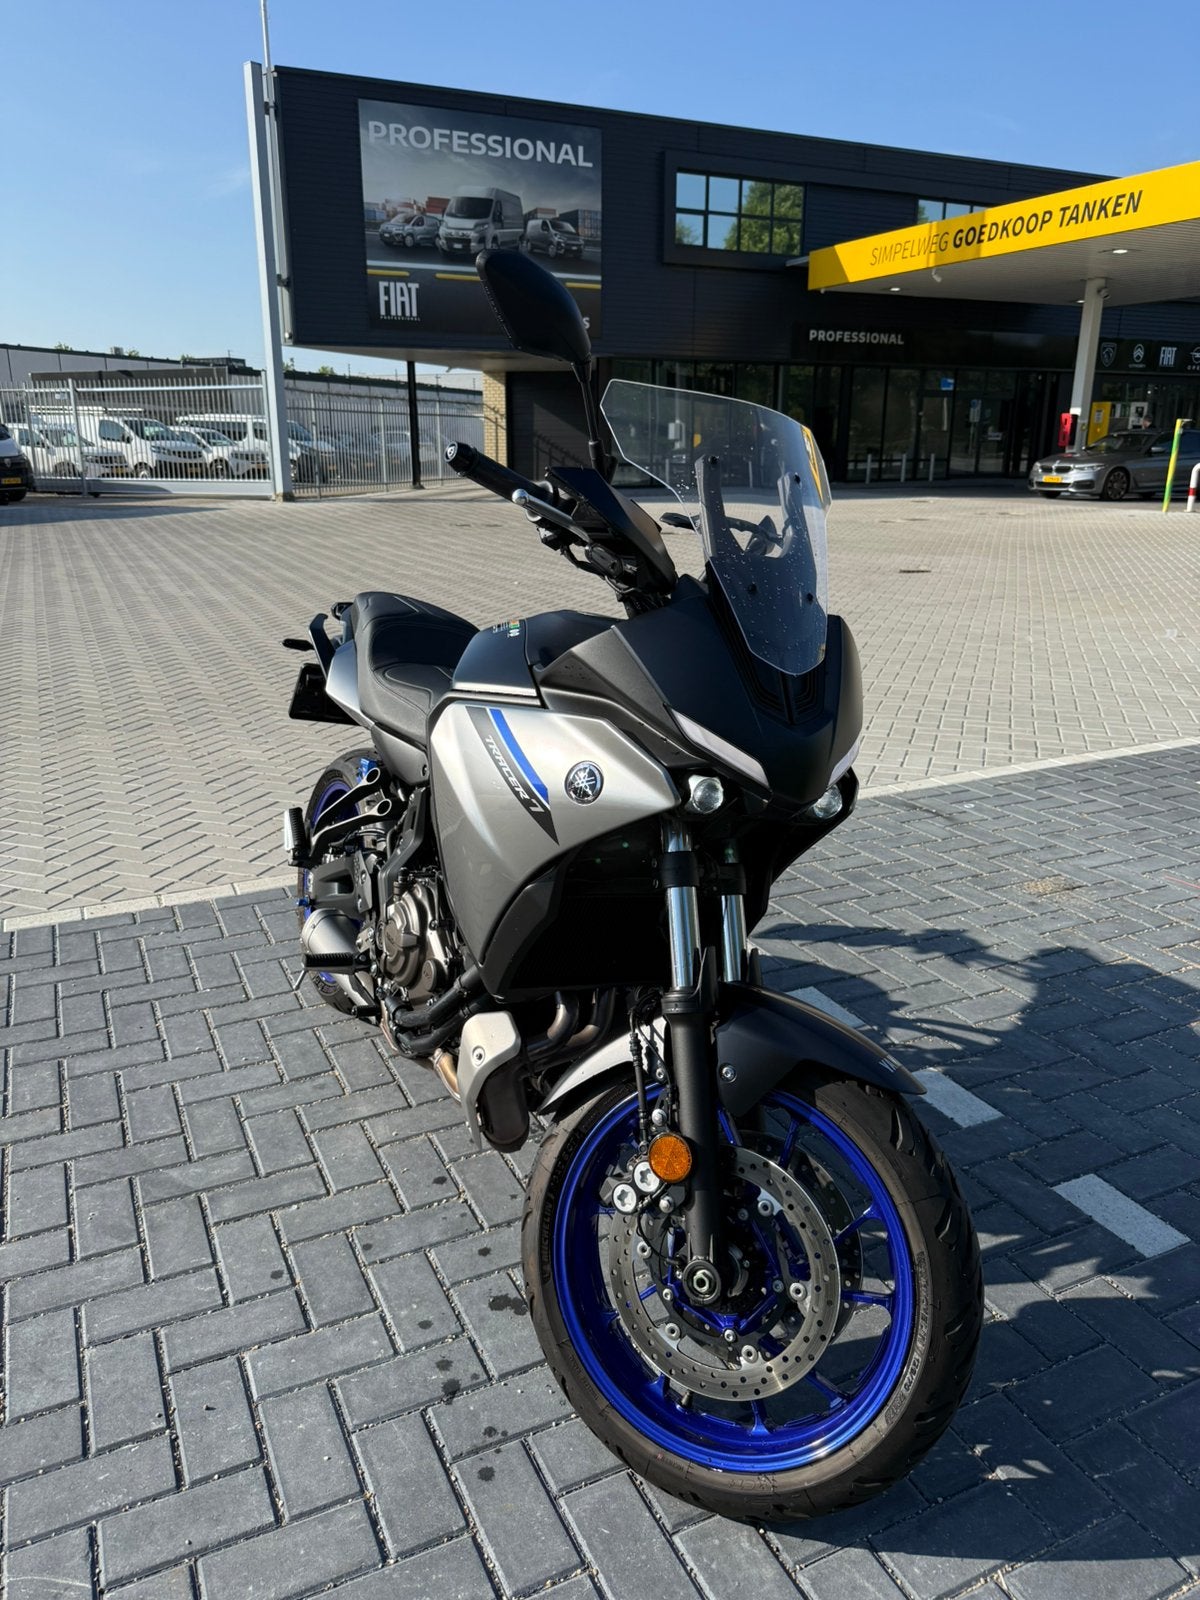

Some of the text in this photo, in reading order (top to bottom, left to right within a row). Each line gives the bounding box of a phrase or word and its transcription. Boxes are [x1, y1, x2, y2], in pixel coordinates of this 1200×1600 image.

[367, 120, 593, 168] PROFESSIONAL
[870, 190, 1143, 266] SIMPELWEG GOEDKOOP TANKEN
[379, 281, 419, 317] FIAT
[809, 330, 904, 345] PROFESSIONAL
[1159, 347, 1177, 367] FIAT
[485, 735, 545, 812] TRACER 7
